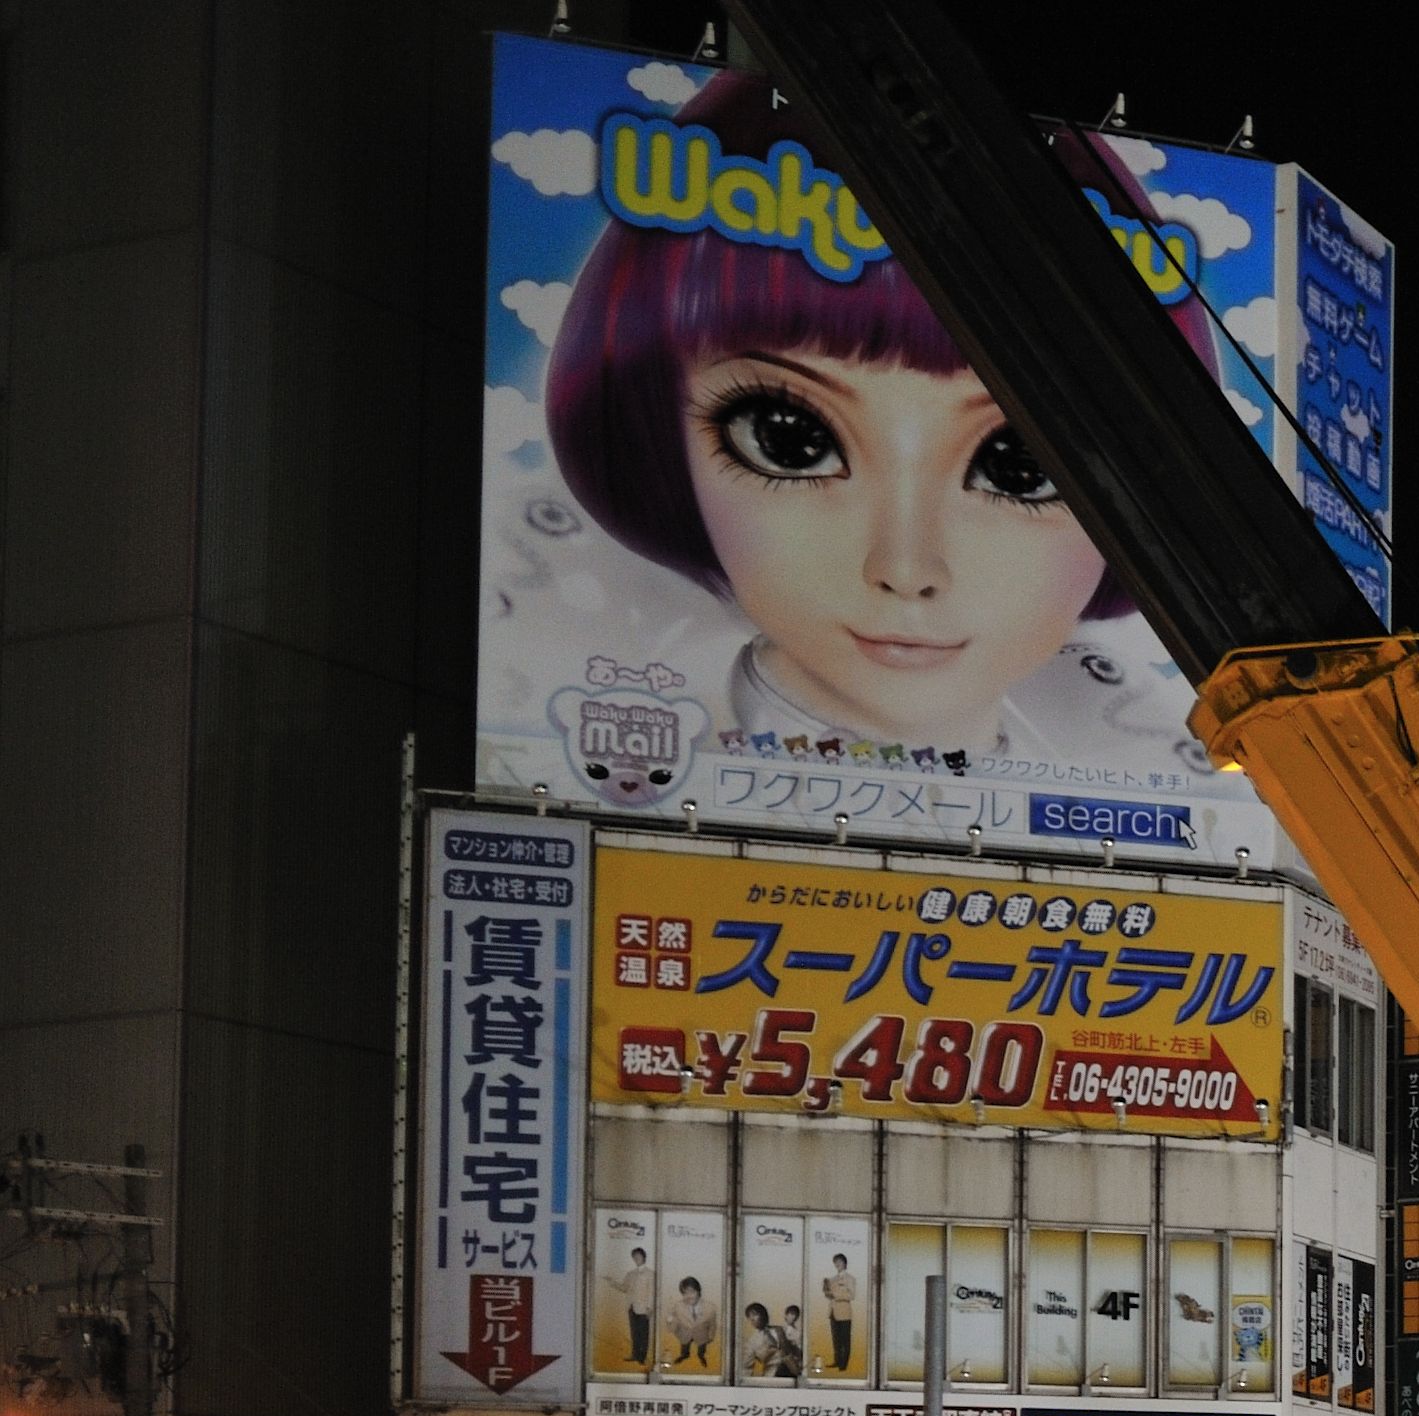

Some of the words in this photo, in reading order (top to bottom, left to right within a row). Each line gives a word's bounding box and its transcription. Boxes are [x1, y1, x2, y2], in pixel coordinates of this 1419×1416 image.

[719, 768, 1013, 827] ワクワクメール
[1044, 801, 1177, 840] search
[447, 835, 572, 867] マンション仲介・管理
[446, 874, 571, 904] 法人・社宅・受付
[746, 883, 915, 912] からだにおいしい
[918, 887, 1156, 937] 健康朝食無料
[617, 917, 689, 950] 天然
[617, 953, 689, 988] 温泉
[695, 919, 1277, 1026] スーパーホテル
[621, 1041, 684, 1079] 税込
[692, 1009, 1047, 1113] ¥5,480
[1071, 1030, 1207, 1056] 谷町筋北上・左手
[461, 914, 544, 1225] 賃貸住宅
[1068, 1061, 1239, 1110] 06-4305-9000
[461, 1228, 538, 1270] サービス
[1035, 1303, 1078, 1320] Building
[1046, 1290, 1068, 1304] This
[1096, 1290, 1141, 1321] 4F
[480, 1275, 522, 1387] 当ビル1F
